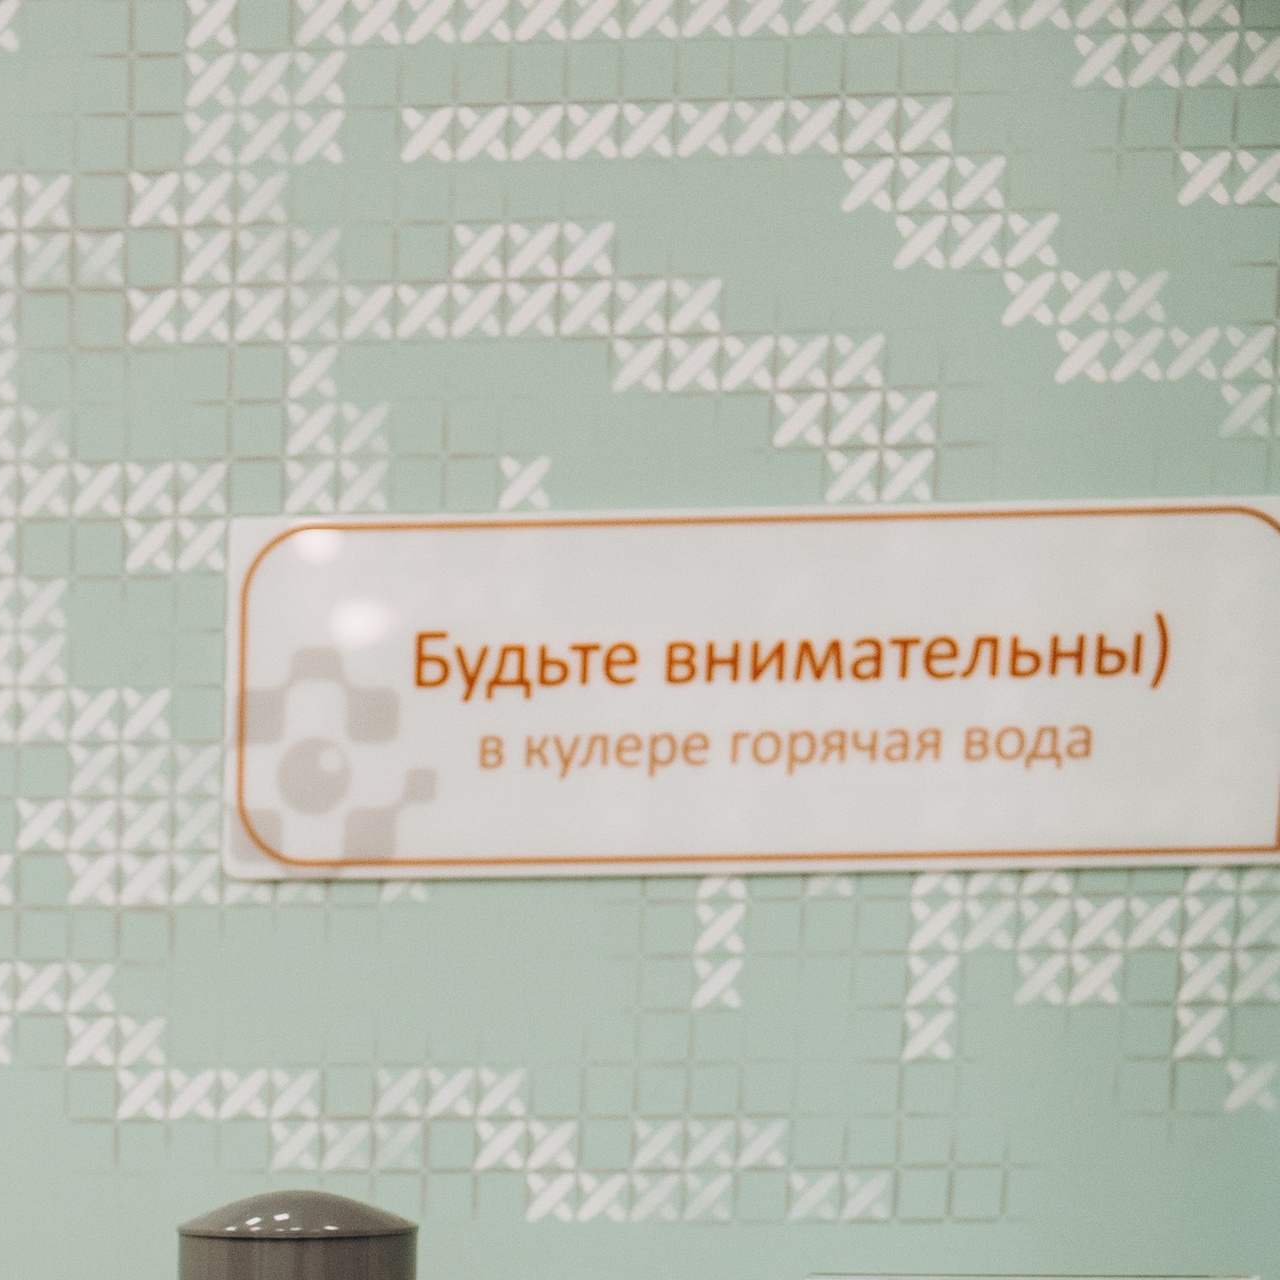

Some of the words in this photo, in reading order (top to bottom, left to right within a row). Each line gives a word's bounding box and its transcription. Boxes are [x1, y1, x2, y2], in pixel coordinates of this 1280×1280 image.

[412, 629, 641, 703] Будьте
[664, 611, 1171, 689] внимательны)
[478, 735, 504, 770] в
[524, 730, 711, 777] кулере
[730, 726, 943, 776] горячая
[963, 722, 1095, 768] вода
